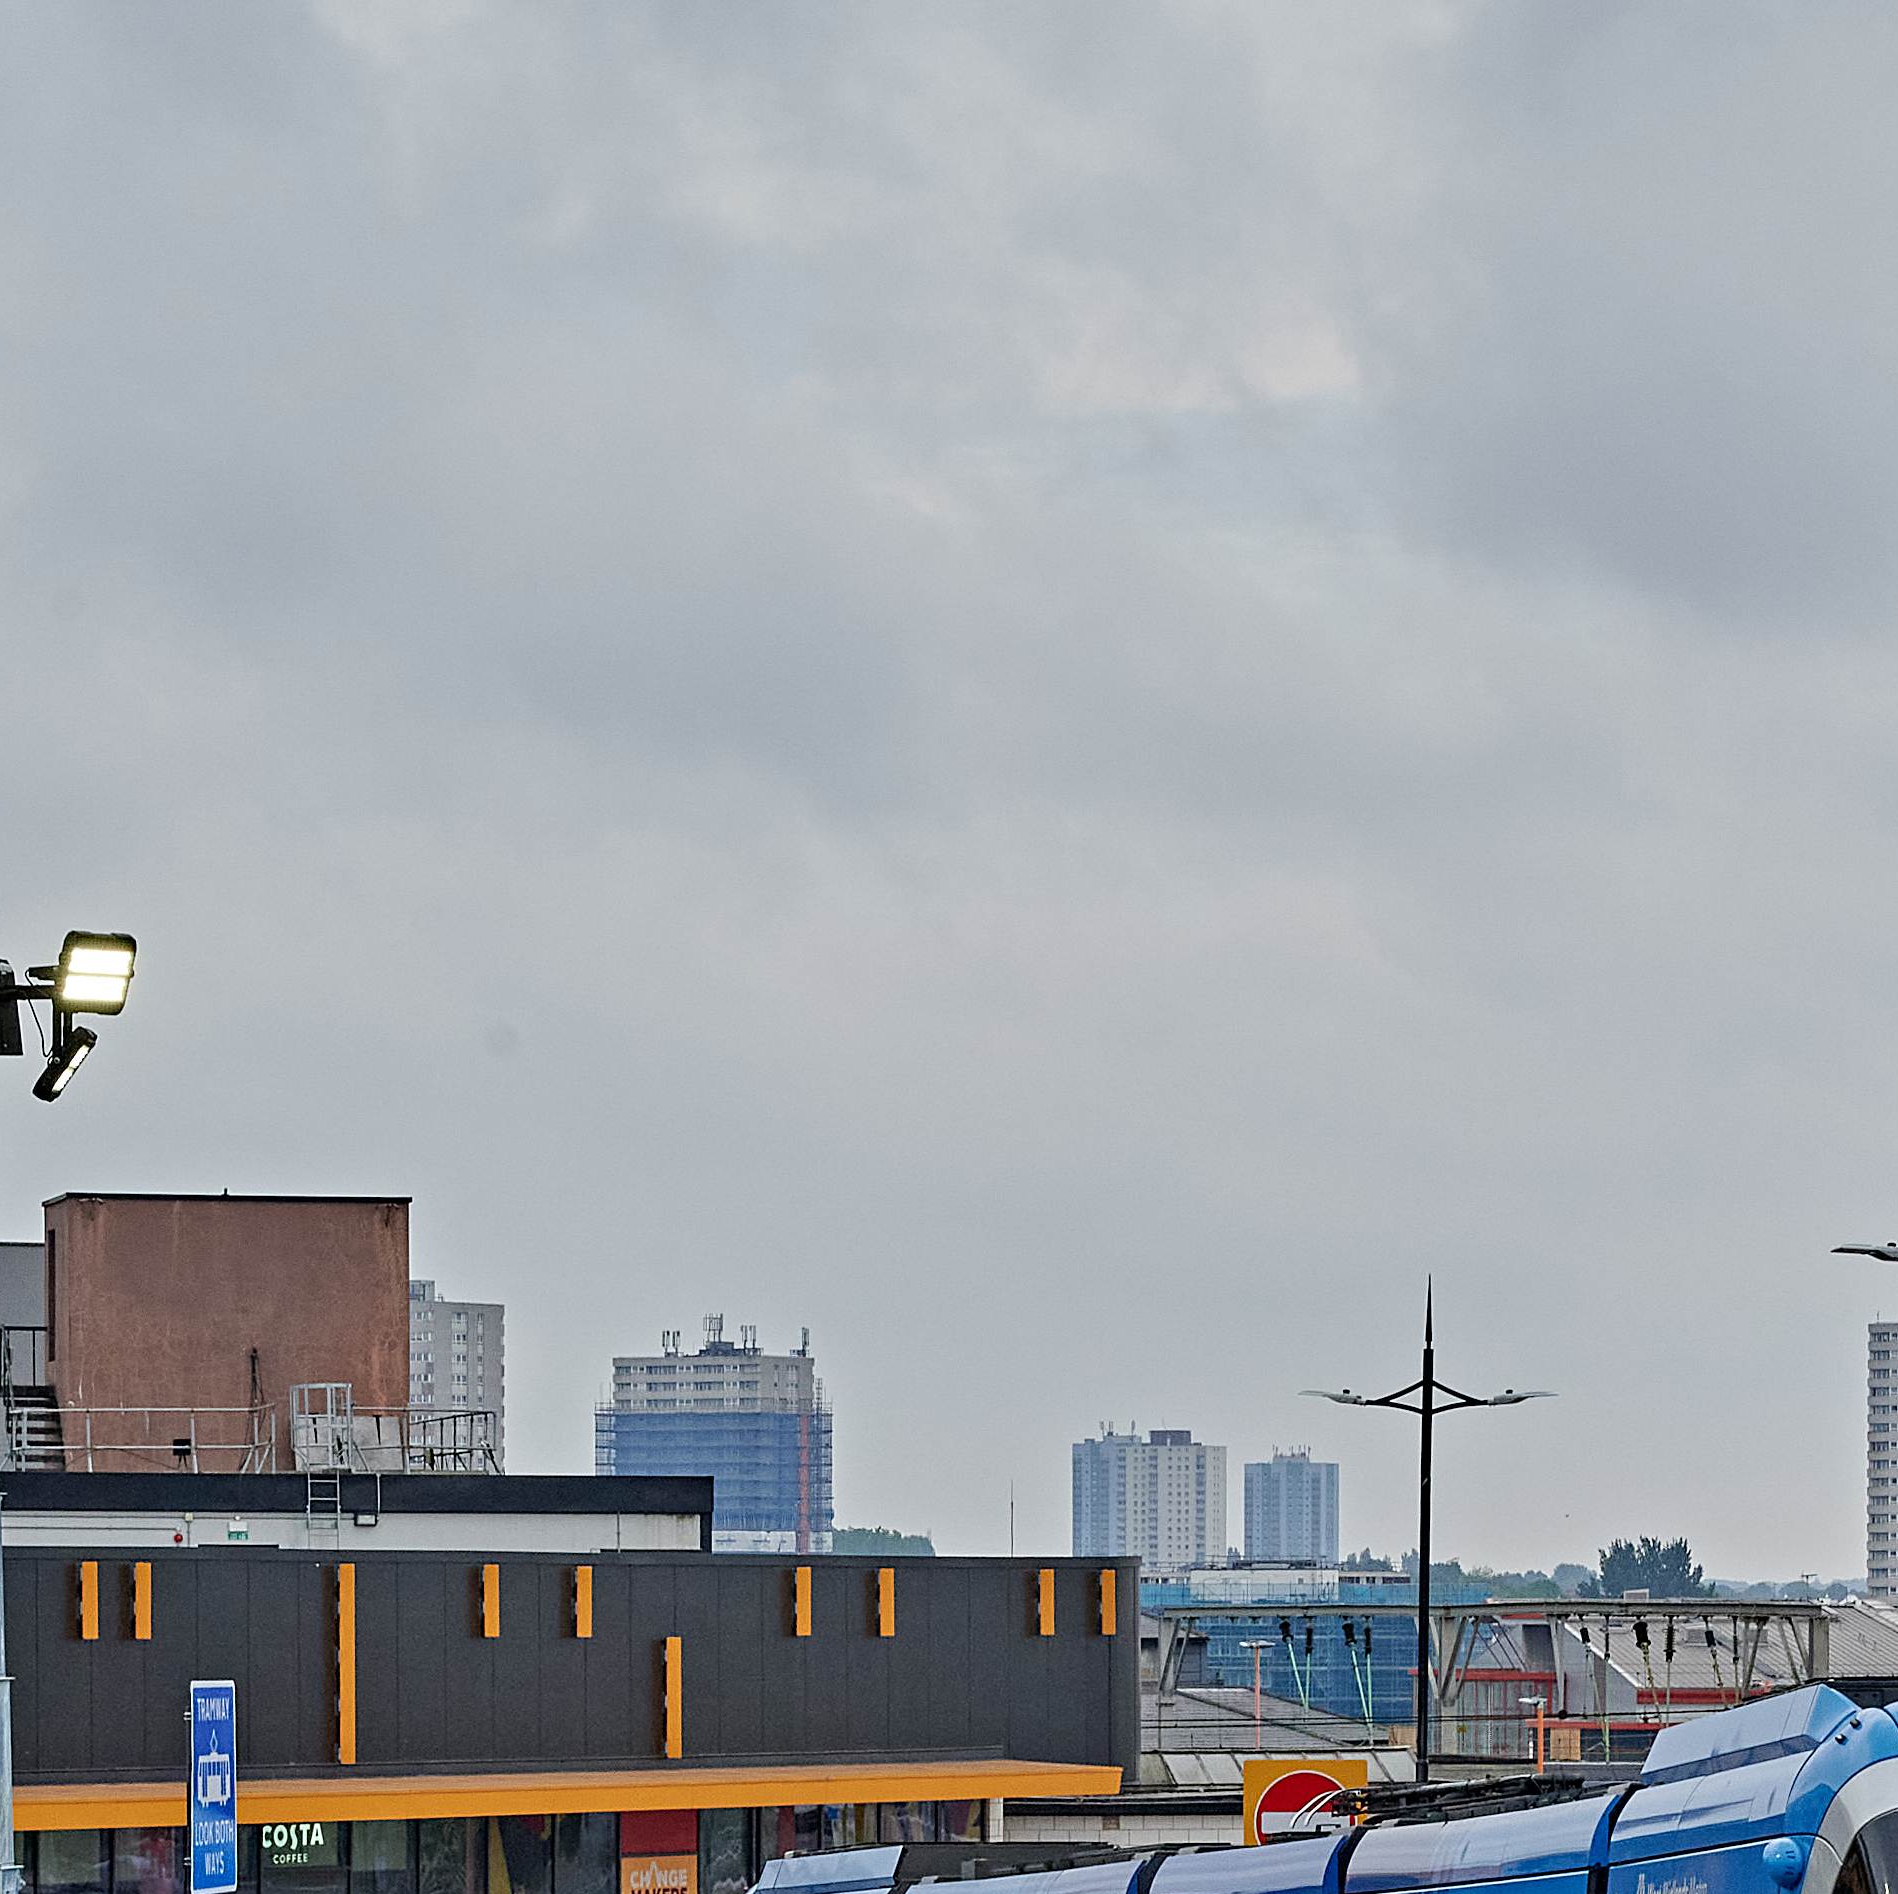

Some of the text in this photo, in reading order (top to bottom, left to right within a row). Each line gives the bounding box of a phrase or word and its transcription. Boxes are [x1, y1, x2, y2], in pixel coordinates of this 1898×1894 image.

[196, 1698, 230, 1721] TRAMWAY
[195, 1818, 234, 1847] LOOK BOTH
[262, 1823, 324, 1850] COSTA
[204, 1851, 225, 1876] WAYS
[272, 1852, 309, 1865] COFFEE
[630, 1861, 688, 1889] CHANGE
